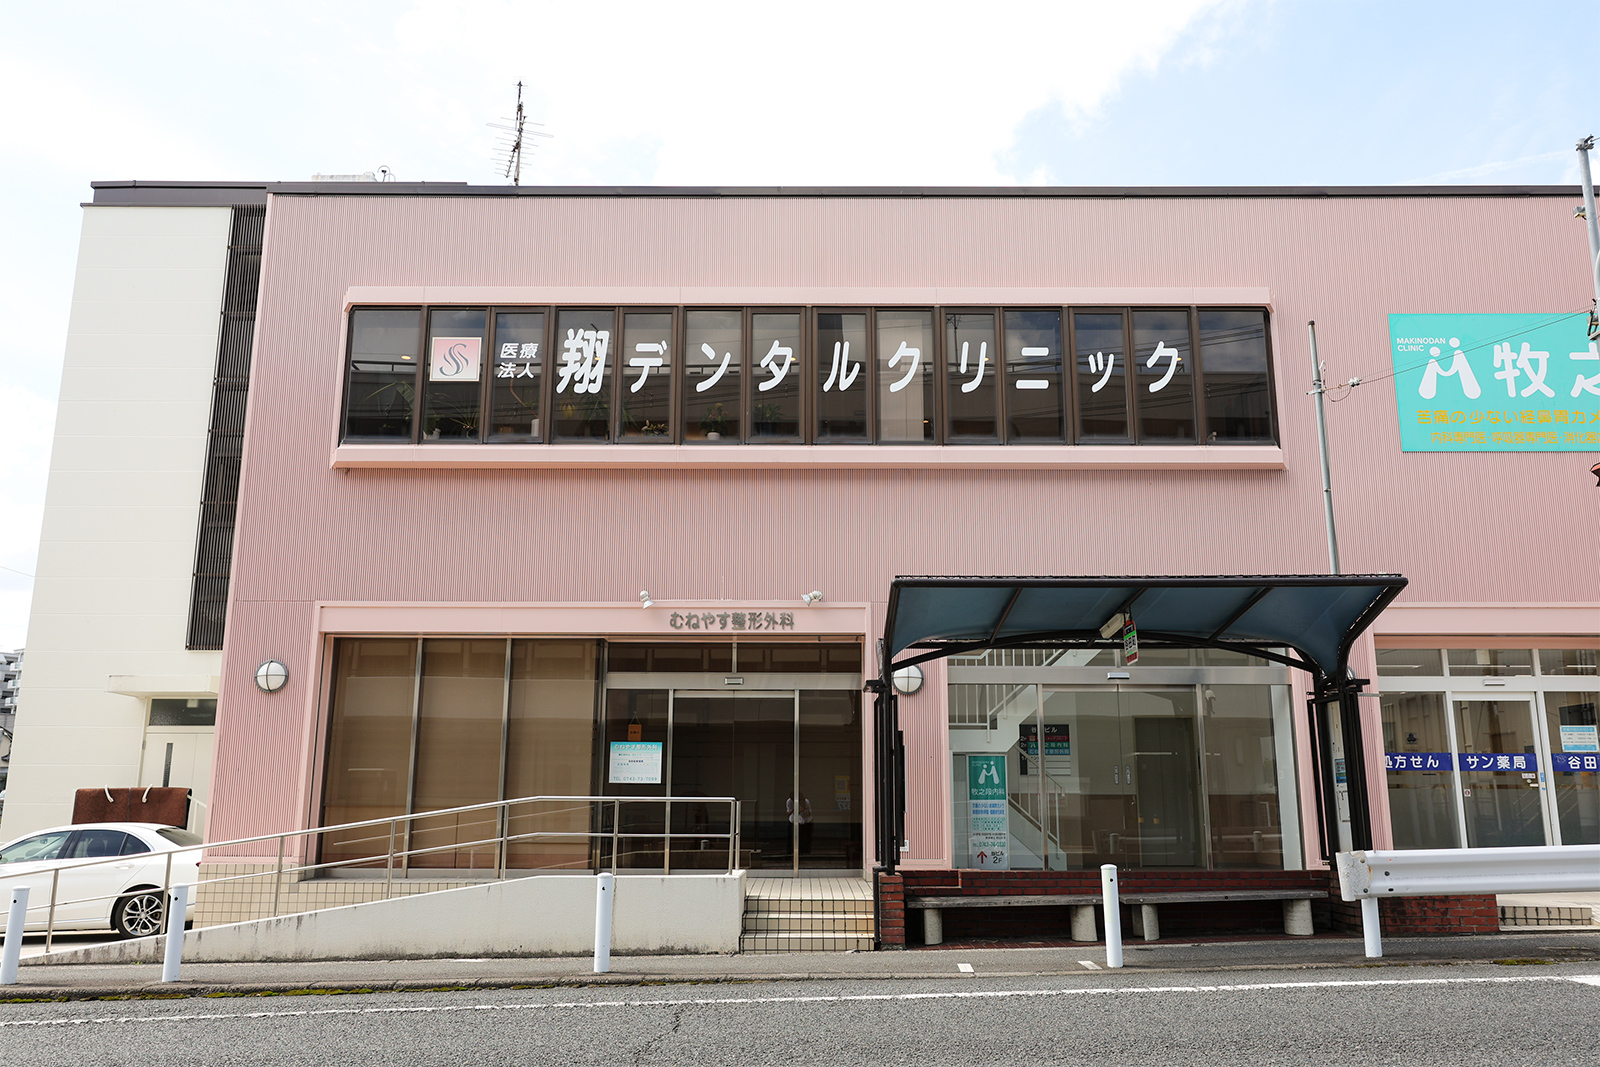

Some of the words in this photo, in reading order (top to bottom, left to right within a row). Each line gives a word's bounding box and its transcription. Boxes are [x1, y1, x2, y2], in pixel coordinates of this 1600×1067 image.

[1396, 337, 1446, 345] MAKINODAN
[1397, 344, 1425, 352] CLINIC
[500, 342, 539, 360] 医療
[556, 328, 1179, 394] 翔デンタルクリニック
[497, 361, 536, 379] 法人
[1430, 431, 1600, 444] 内科専門医・呼吸器専門医・消化器
[669, 612, 795, 630] むねやす整形外科
[1466, 755, 1527, 769] サン薬局
[1567, 755, 1598, 770] 谷田
